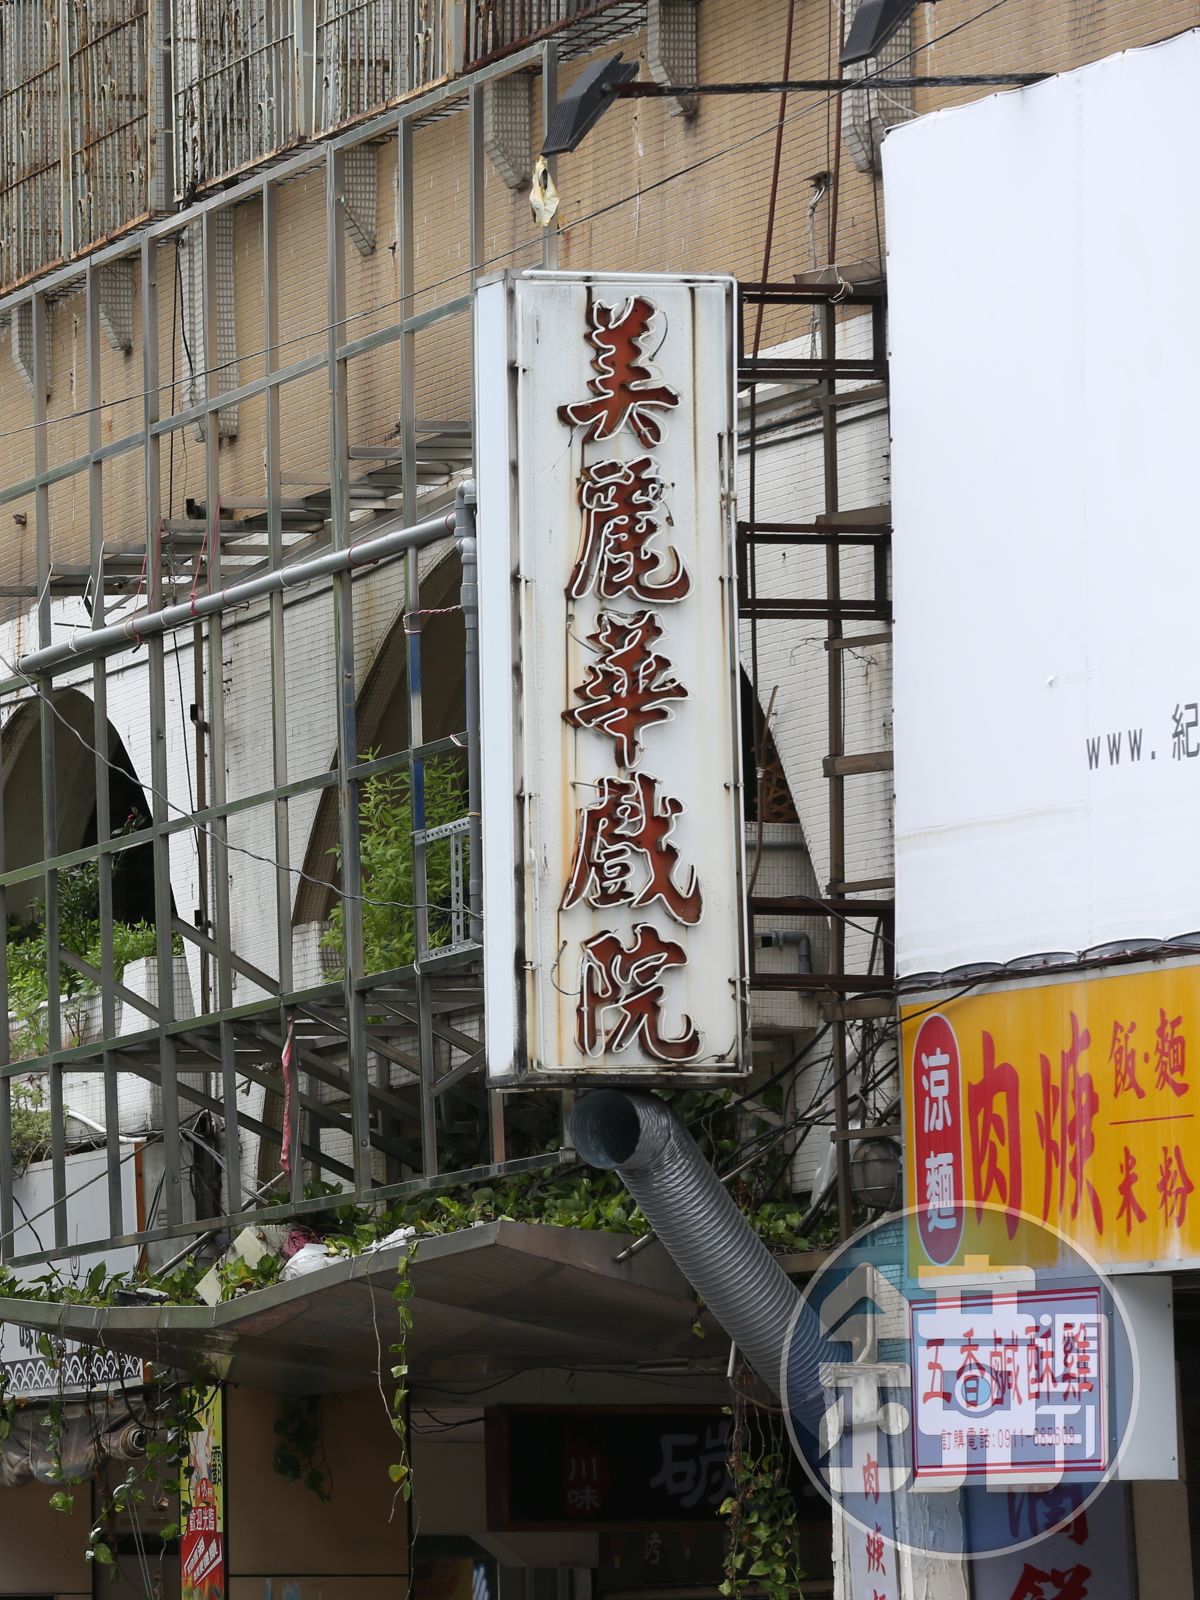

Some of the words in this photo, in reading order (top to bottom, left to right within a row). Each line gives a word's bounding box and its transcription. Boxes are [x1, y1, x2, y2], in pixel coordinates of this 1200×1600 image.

[557, 295, 703, 1062] 美麗華戲院
[921, 1047, 957, 1232] 涼麵
[1116, 1145, 1195, 1236] 米粉
[567, 1456, 601, 1510] 川味
